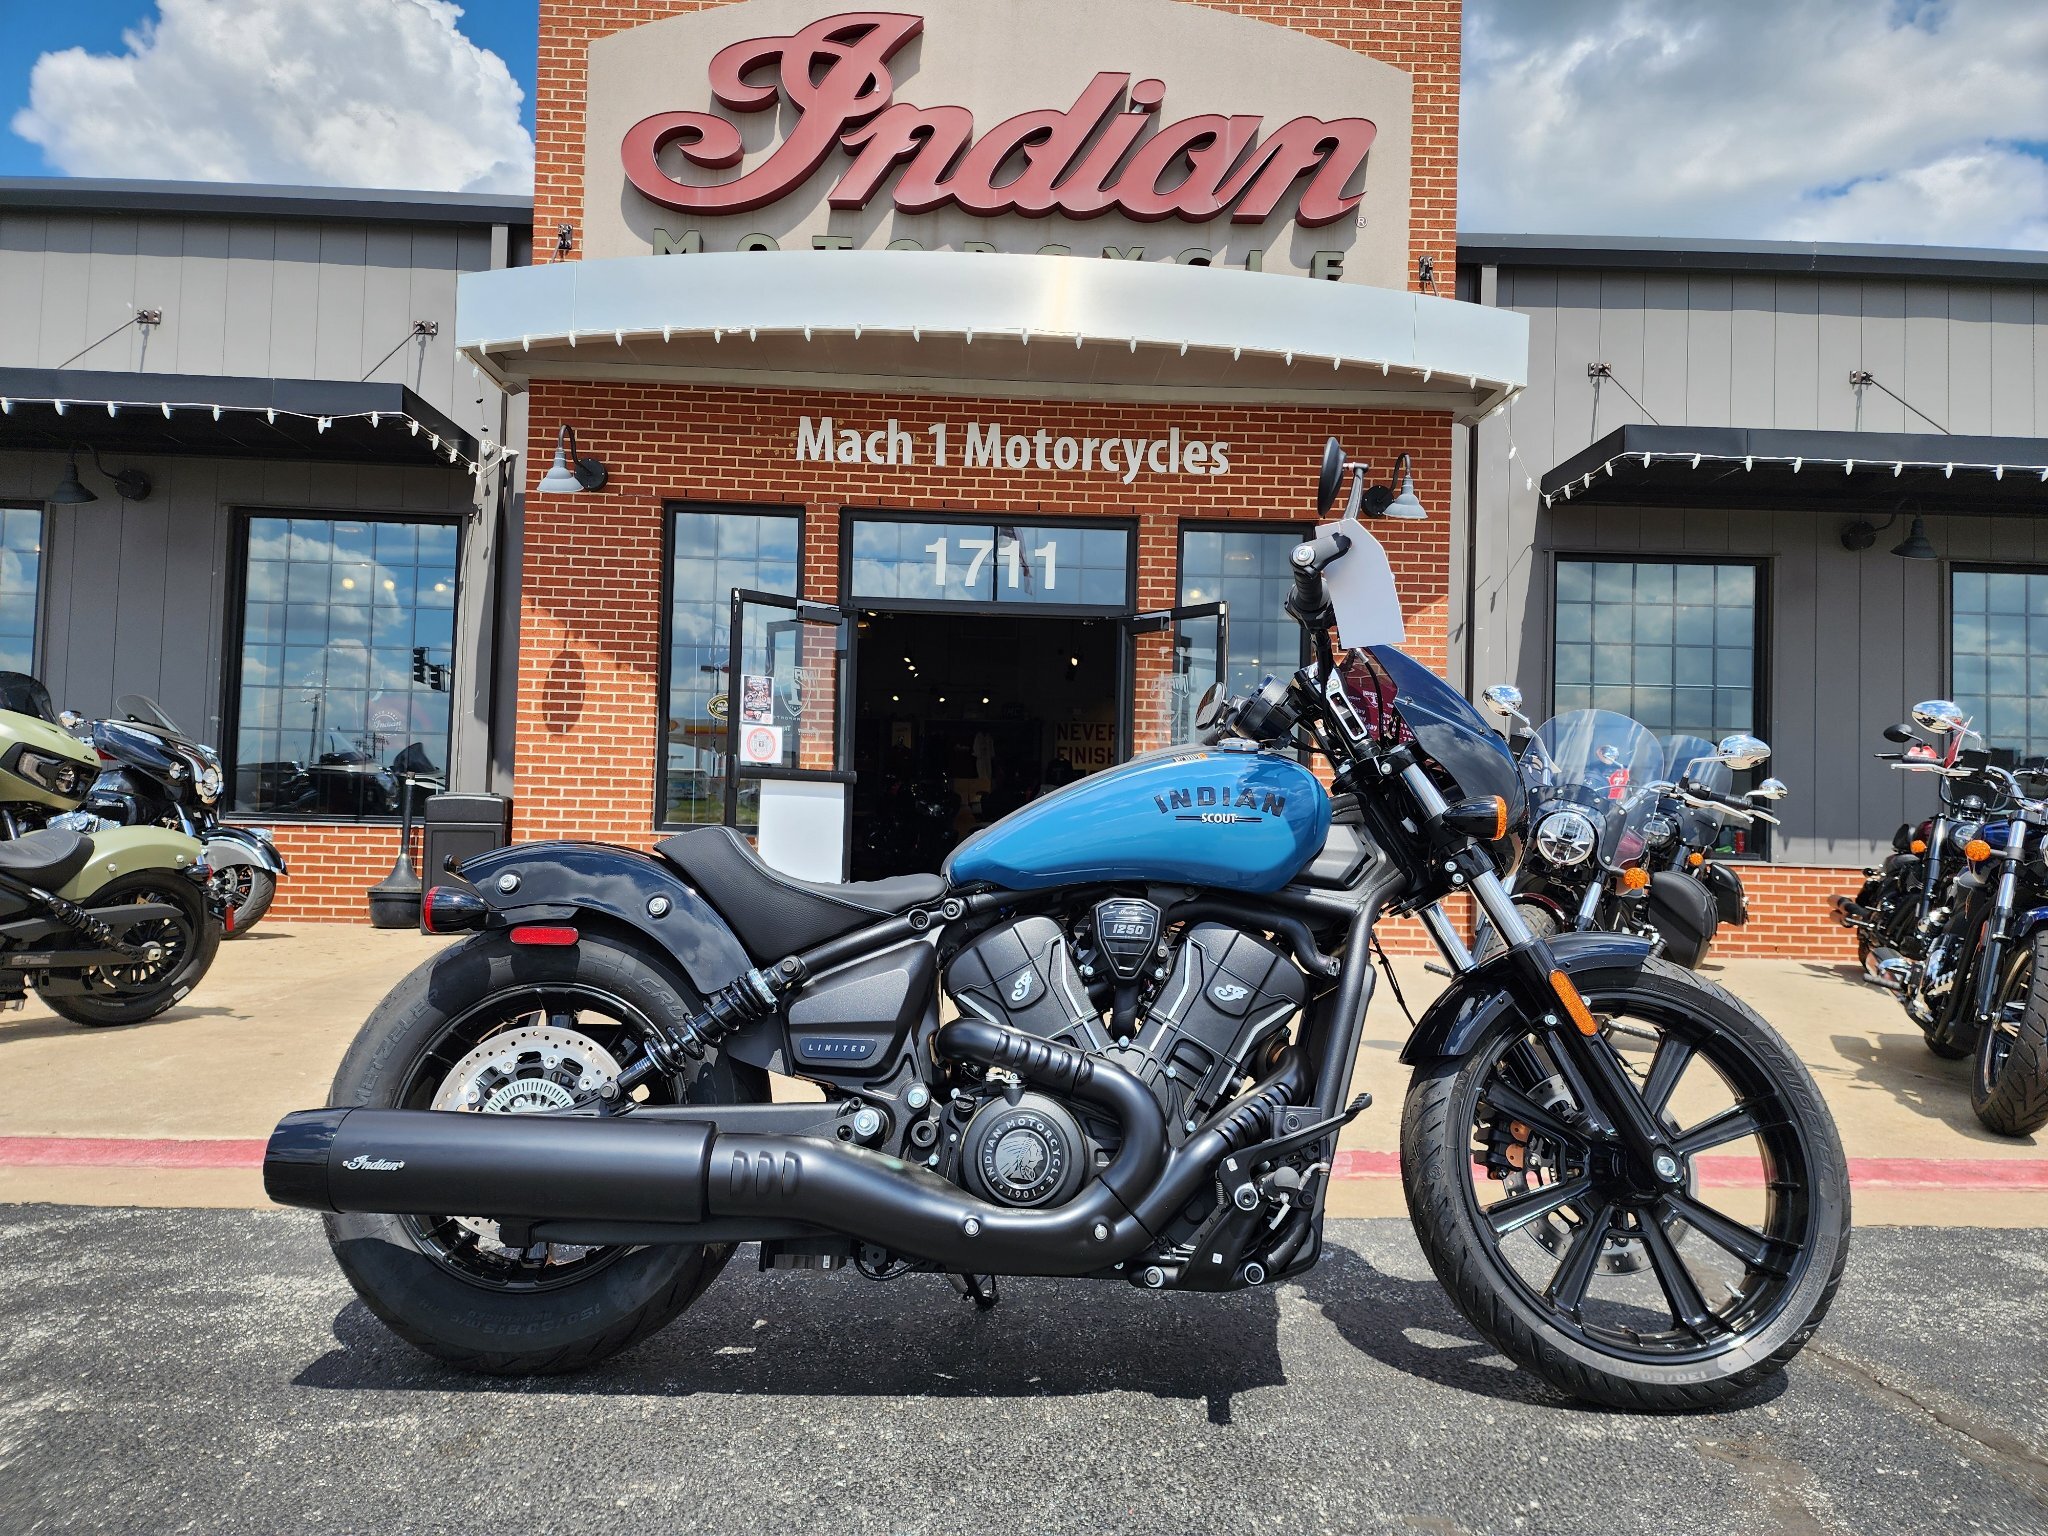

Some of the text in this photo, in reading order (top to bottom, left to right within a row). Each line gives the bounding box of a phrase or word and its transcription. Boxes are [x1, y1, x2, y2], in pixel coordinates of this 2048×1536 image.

[620, 11, 1377, 228] Indian
[795, 416, 1230, 484] Mach 1 Motorcycles
[924, 537, 1057, 590] 1711
[1153, 786, 1287, 817] INDIAN
[1201, 813, 1238, 824] SCOUT
[1112, 923, 1145, 935] 1250
[808, 1044, 866, 1053] LIMITED
[347, 1154, 400, 1171] Indian
[984, 1118, 1060, 1184] INDIAN MOTORCYCLE
[1007, 1188, 1036, 1198] 1901
